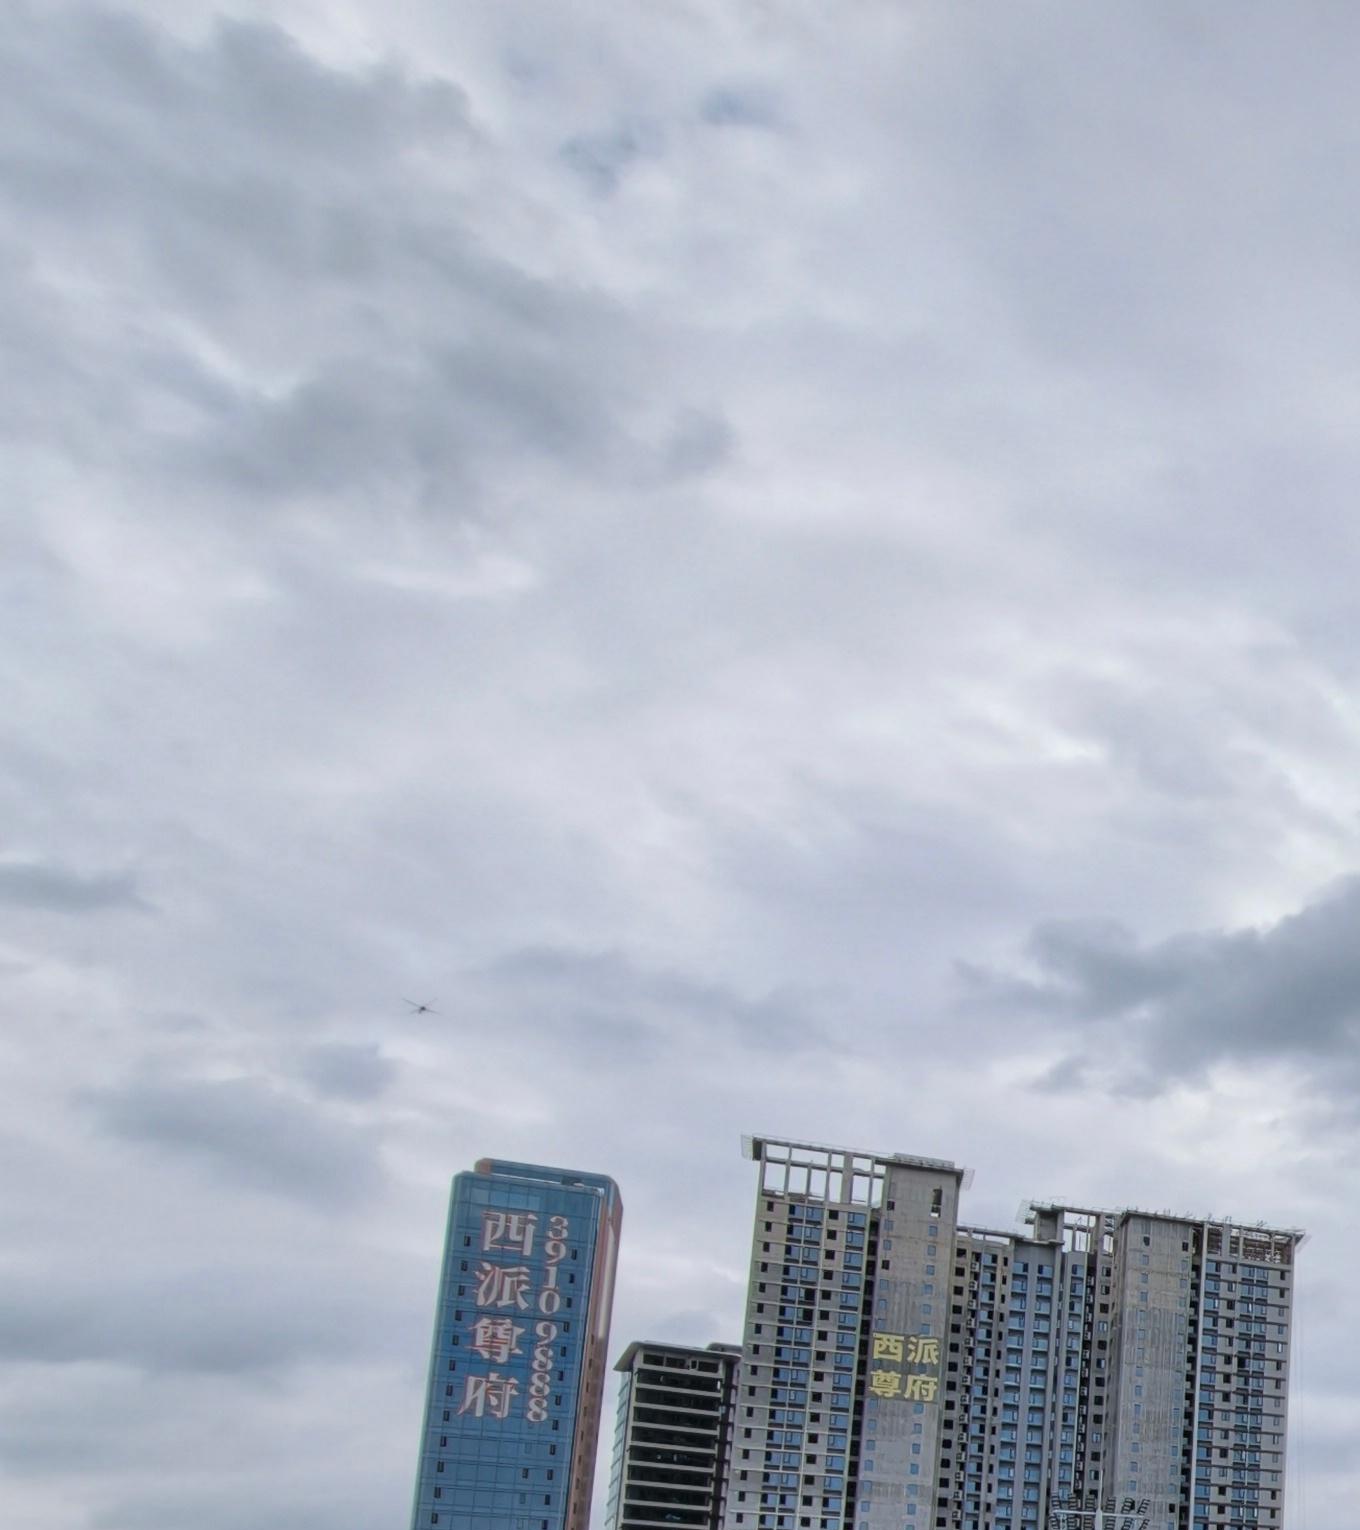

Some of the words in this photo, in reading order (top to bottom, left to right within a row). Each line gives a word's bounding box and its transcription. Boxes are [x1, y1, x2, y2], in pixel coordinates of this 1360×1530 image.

[457, 1211, 538, 1418] 西派尊府
[873, 1333, 938, 1364] 西派
[869, 1369, 937, 1400] 尊府
